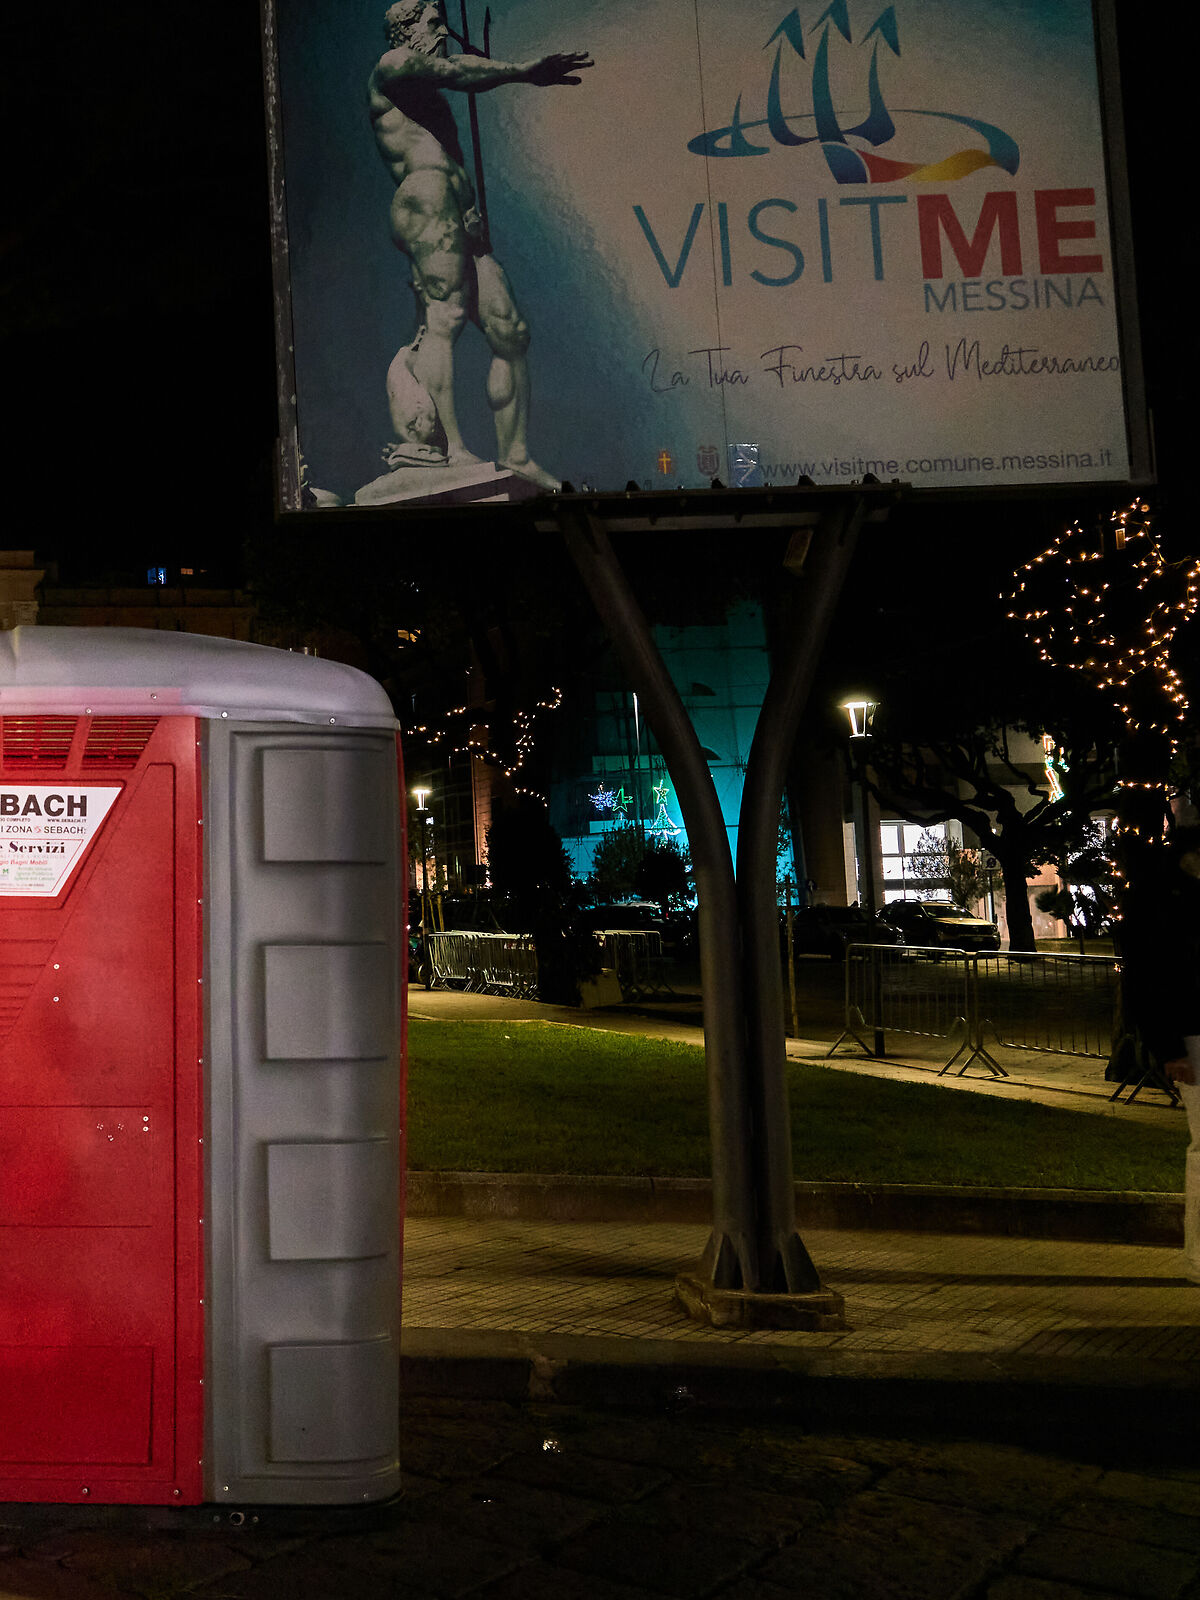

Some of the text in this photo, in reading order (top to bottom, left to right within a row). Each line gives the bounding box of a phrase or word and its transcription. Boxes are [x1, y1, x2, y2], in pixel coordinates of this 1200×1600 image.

[923, 277, 1104, 313] MESSINA
[642, 337, 1120, 393] La Tua Finestra sul Mediterraneo
[760, 448, 1113, 478] www.visitme.comune.messina.it
[6, 825, 33, 834] ZONA
[43, 826, 87, 834] SEBACH:
[9, 841, 65, 853] Servizi
